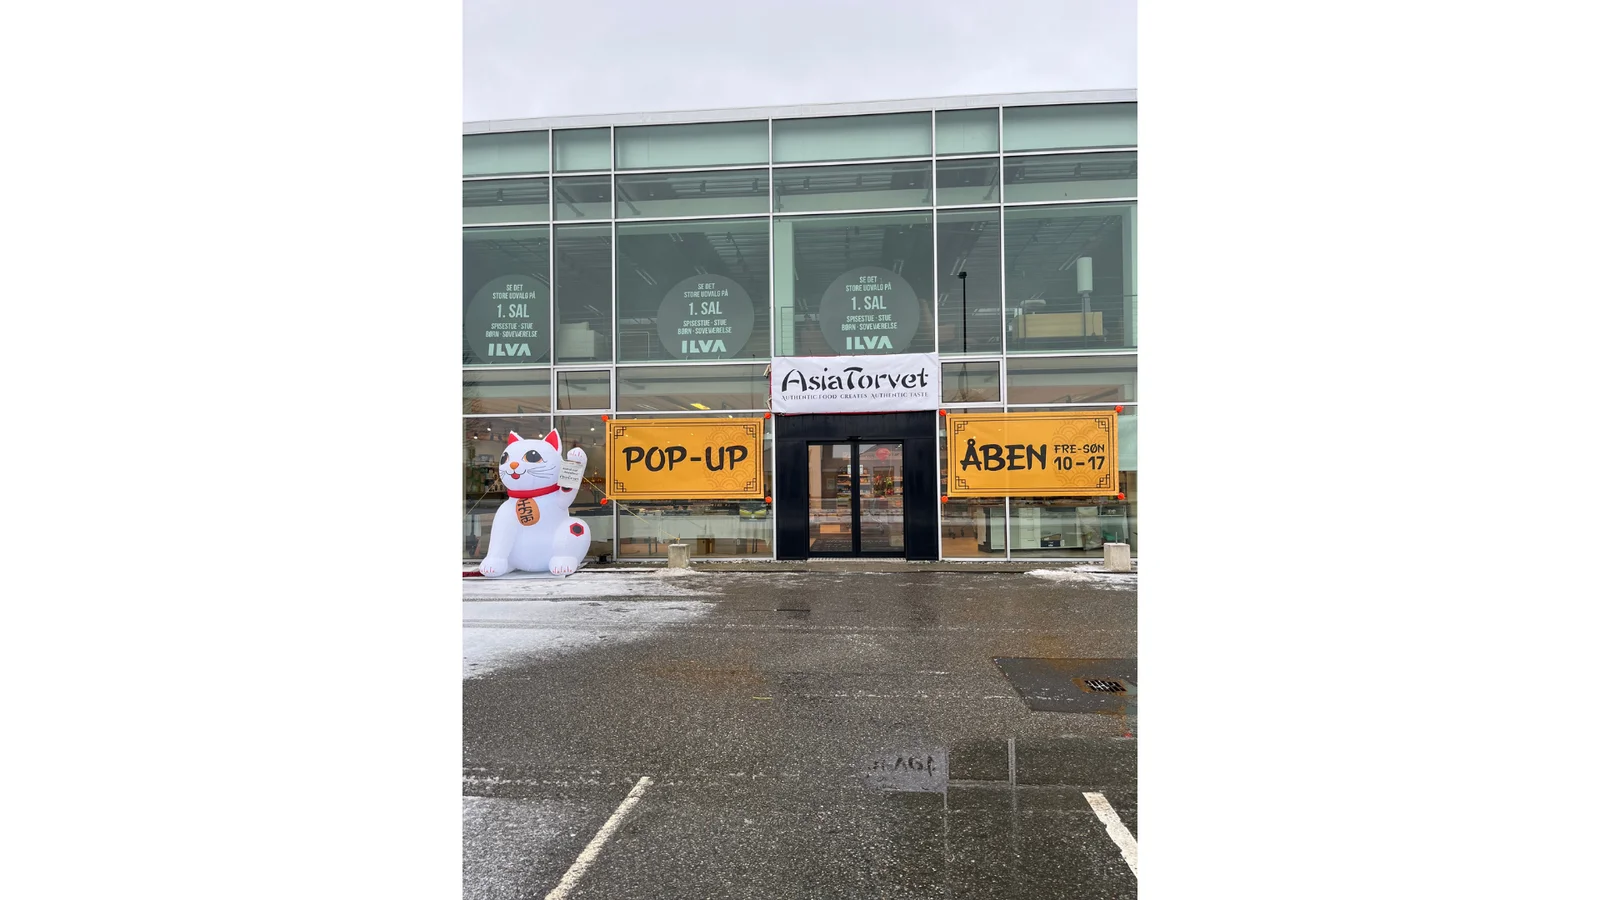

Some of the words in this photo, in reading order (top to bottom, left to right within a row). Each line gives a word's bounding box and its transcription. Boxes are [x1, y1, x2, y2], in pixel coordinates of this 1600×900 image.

[884, 282, 892, 290] PÅ
[529, 291, 536, 299] PÅ
[689, 302, 698, 316] 1.
[701, 301, 722, 315] SAL
[851, 296, 861, 310] 1.
[864, 295, 887, 310] SAL
[497, 304, 506, 318] 1.
[509, 304, 529, 318] SAL
[488, 343, 531, 356] ILVA
[682, 340, 727, 353] ILVA
[846, 336, 893, 350] ILVA
[782, 367, 929, 392] AsiaTorvet
[960, 438, 1047, 471] ÅBEN
[1054, 444, 1105, 454] FRE-SØN
[622, 445, 748, 472] POP-UP
